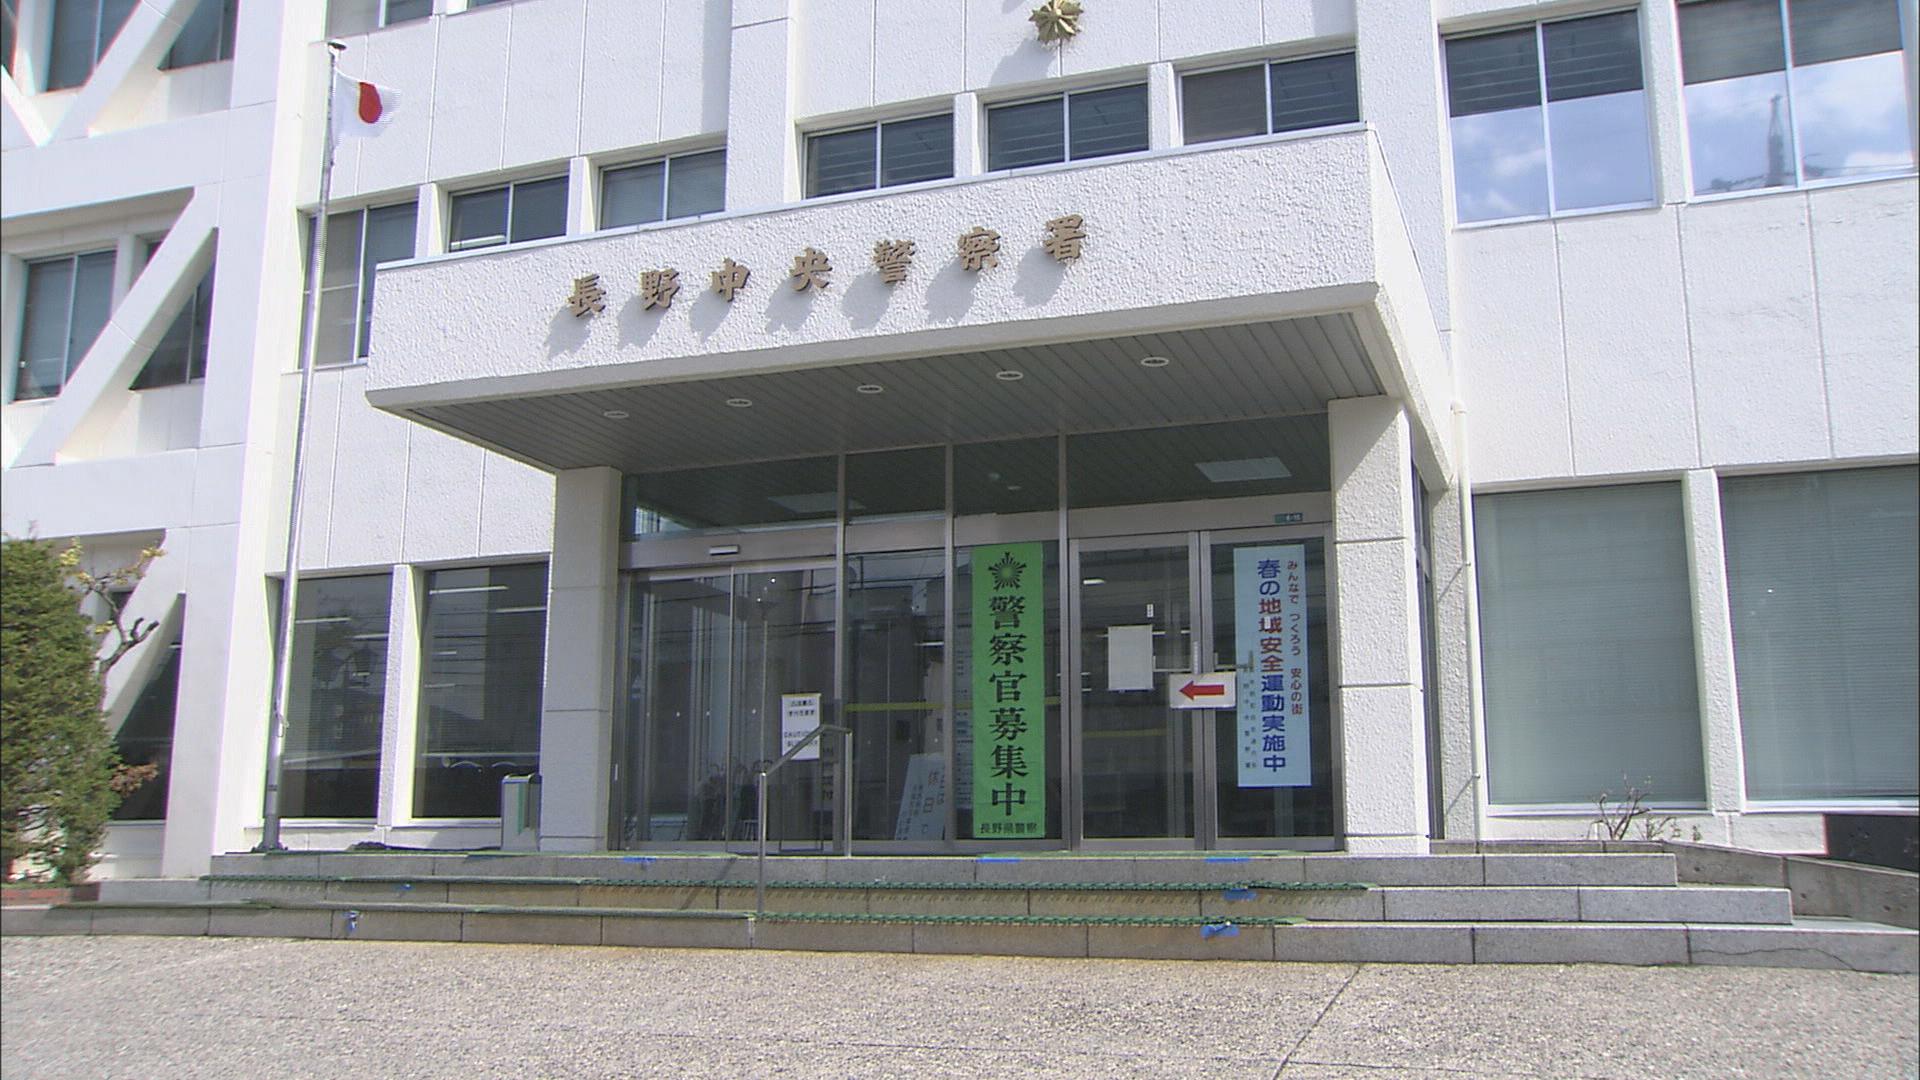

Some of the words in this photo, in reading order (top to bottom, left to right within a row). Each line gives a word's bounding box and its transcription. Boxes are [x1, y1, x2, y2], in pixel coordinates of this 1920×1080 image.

[568, 214, 1086, 318] 長野中央警察署
[1287, 560, 1300, 605] みんなで
[1257, 559, 1287, 773] 春の地域安全運動実施中
[1290, 668, 1304, 716] 安心の街
[988, 595, 1030, 816] 警察官募集中
[979, 821, 1038, 835] 長野県警察
